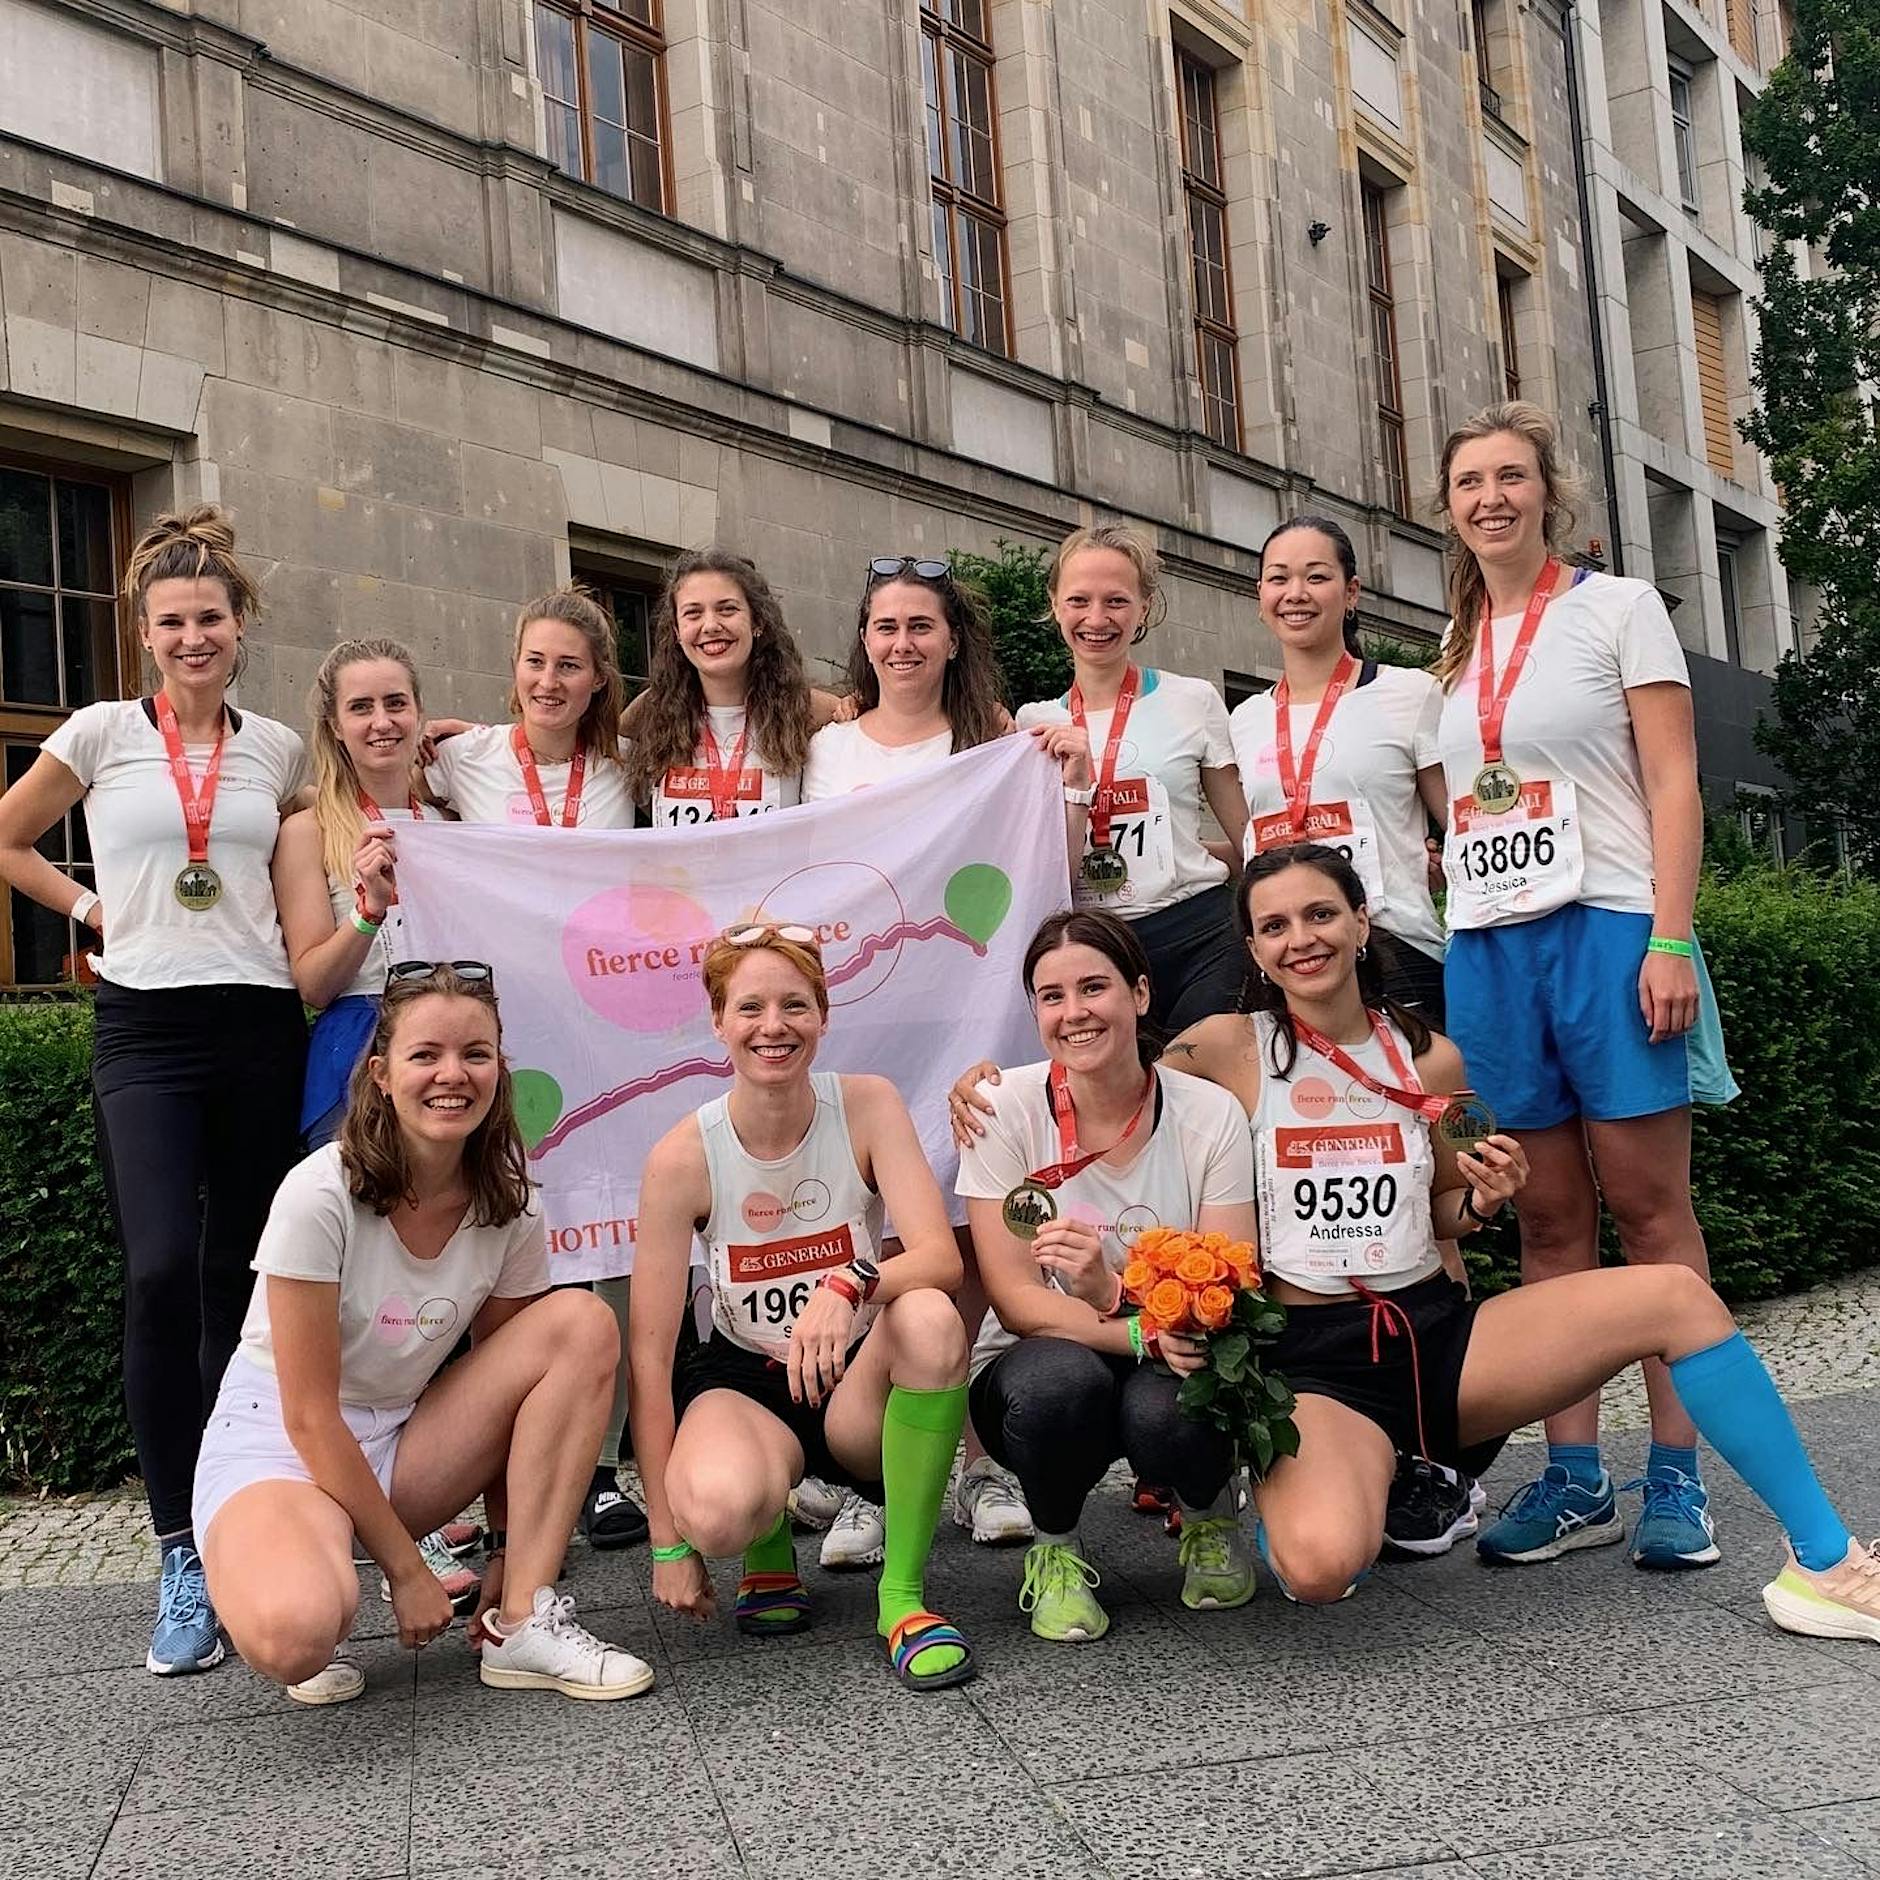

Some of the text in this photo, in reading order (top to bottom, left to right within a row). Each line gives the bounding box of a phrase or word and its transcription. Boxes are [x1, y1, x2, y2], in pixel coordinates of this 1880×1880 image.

[1154, 815, 1162, 825] F
[1360, 838, 1368, 848] F
[1460, 826, 1555, 881] 13806
[1561, 818, 1570, 830] F
[1481, 876, 1528, 895] Jessica
[587, 945, 681, 976] fierce
[1297, 1095, 1325, 1103] fierce
[1312, 1135, 1393, 1152] GENERALI
[1294, 1173, 1397, 1222] 9530
[748, 1208, 775, 1217] fierce
[1098, 1224, 1115, 1232] run
[1310, 1224, 1383, 1240] Andressa
[763, 1238, 844, 1269] GENERALI
[742, 1279, 821, 1324] 196
